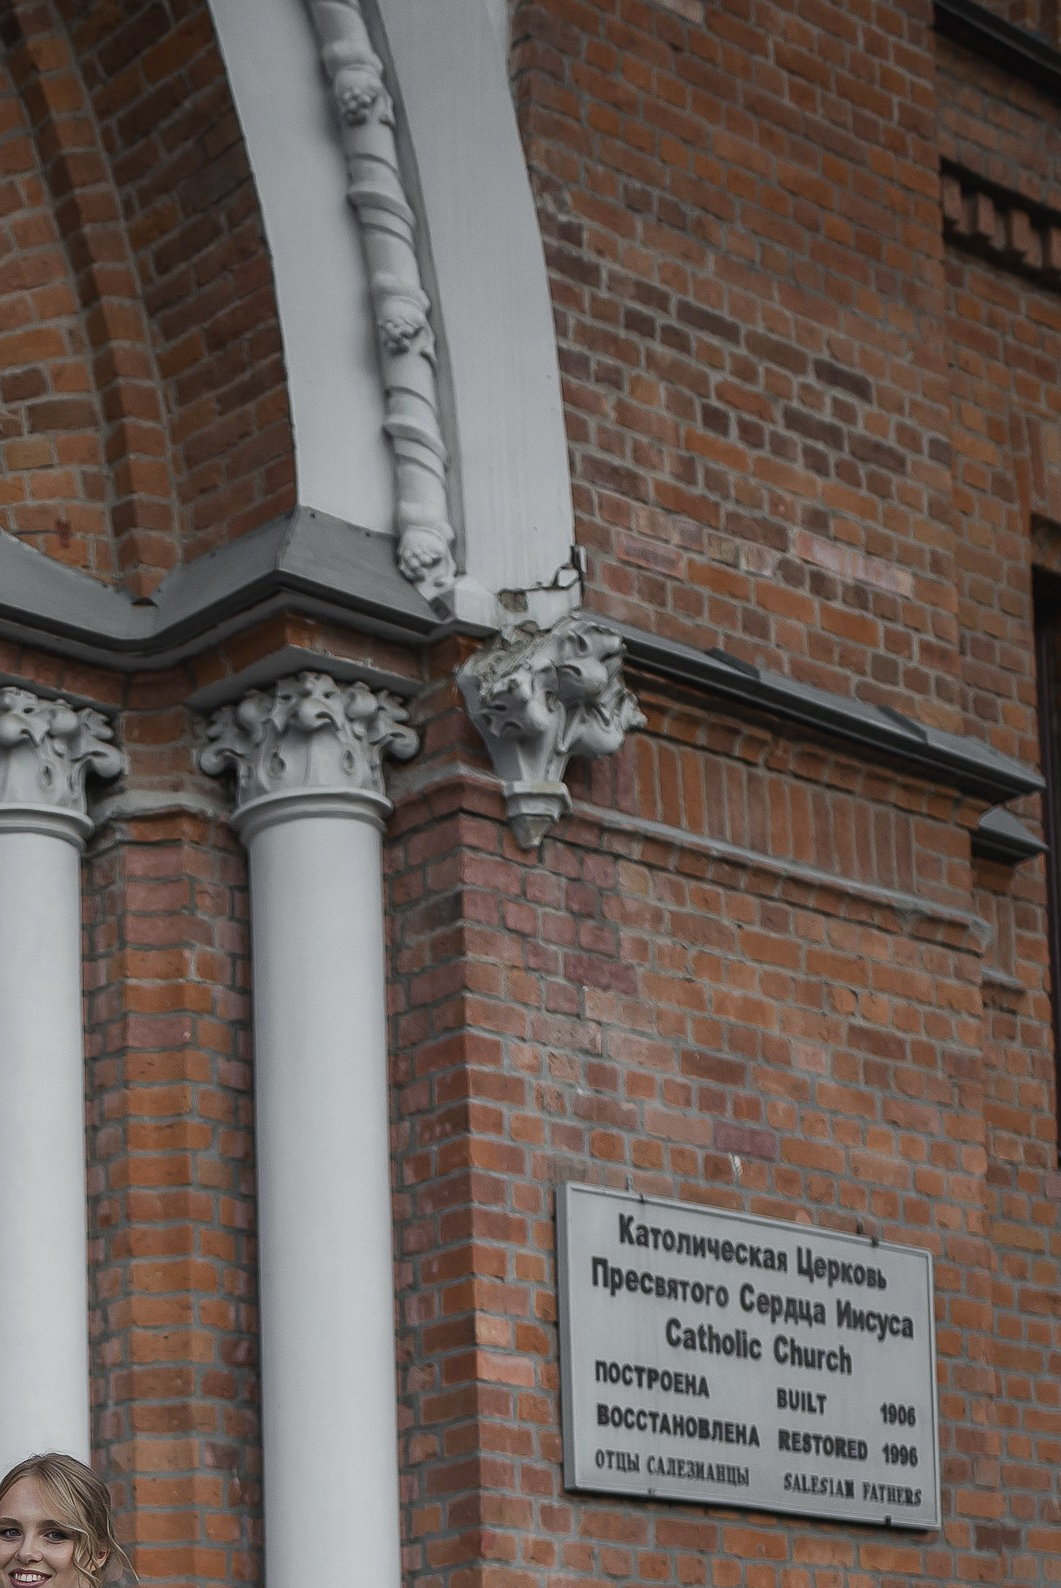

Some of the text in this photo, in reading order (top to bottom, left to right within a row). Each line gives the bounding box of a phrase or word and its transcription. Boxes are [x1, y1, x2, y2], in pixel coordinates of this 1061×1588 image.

[619, 1213, 887, 1290] Католическая Церковь
[592, 1256, 914, 1341] Пресвятого Сердца Иисуса
[666, 1317, 852, 1375] Catholic Church
[595, 1360, 710, 1398] ПОСТРОЕНА
[597, 1403, 760, 1447] ВОССТАНОВЛЕНА
[776, 1387, 916, 1426] BUILT 1906
[595, 1449, 750, 1486] ОТЦЫ САЛЕЗИАНЦЫ
[778, 1429, 919, 1467] RESTORED 1996
[783, 1472, 922, 1506] SALESIAN FATHERS
